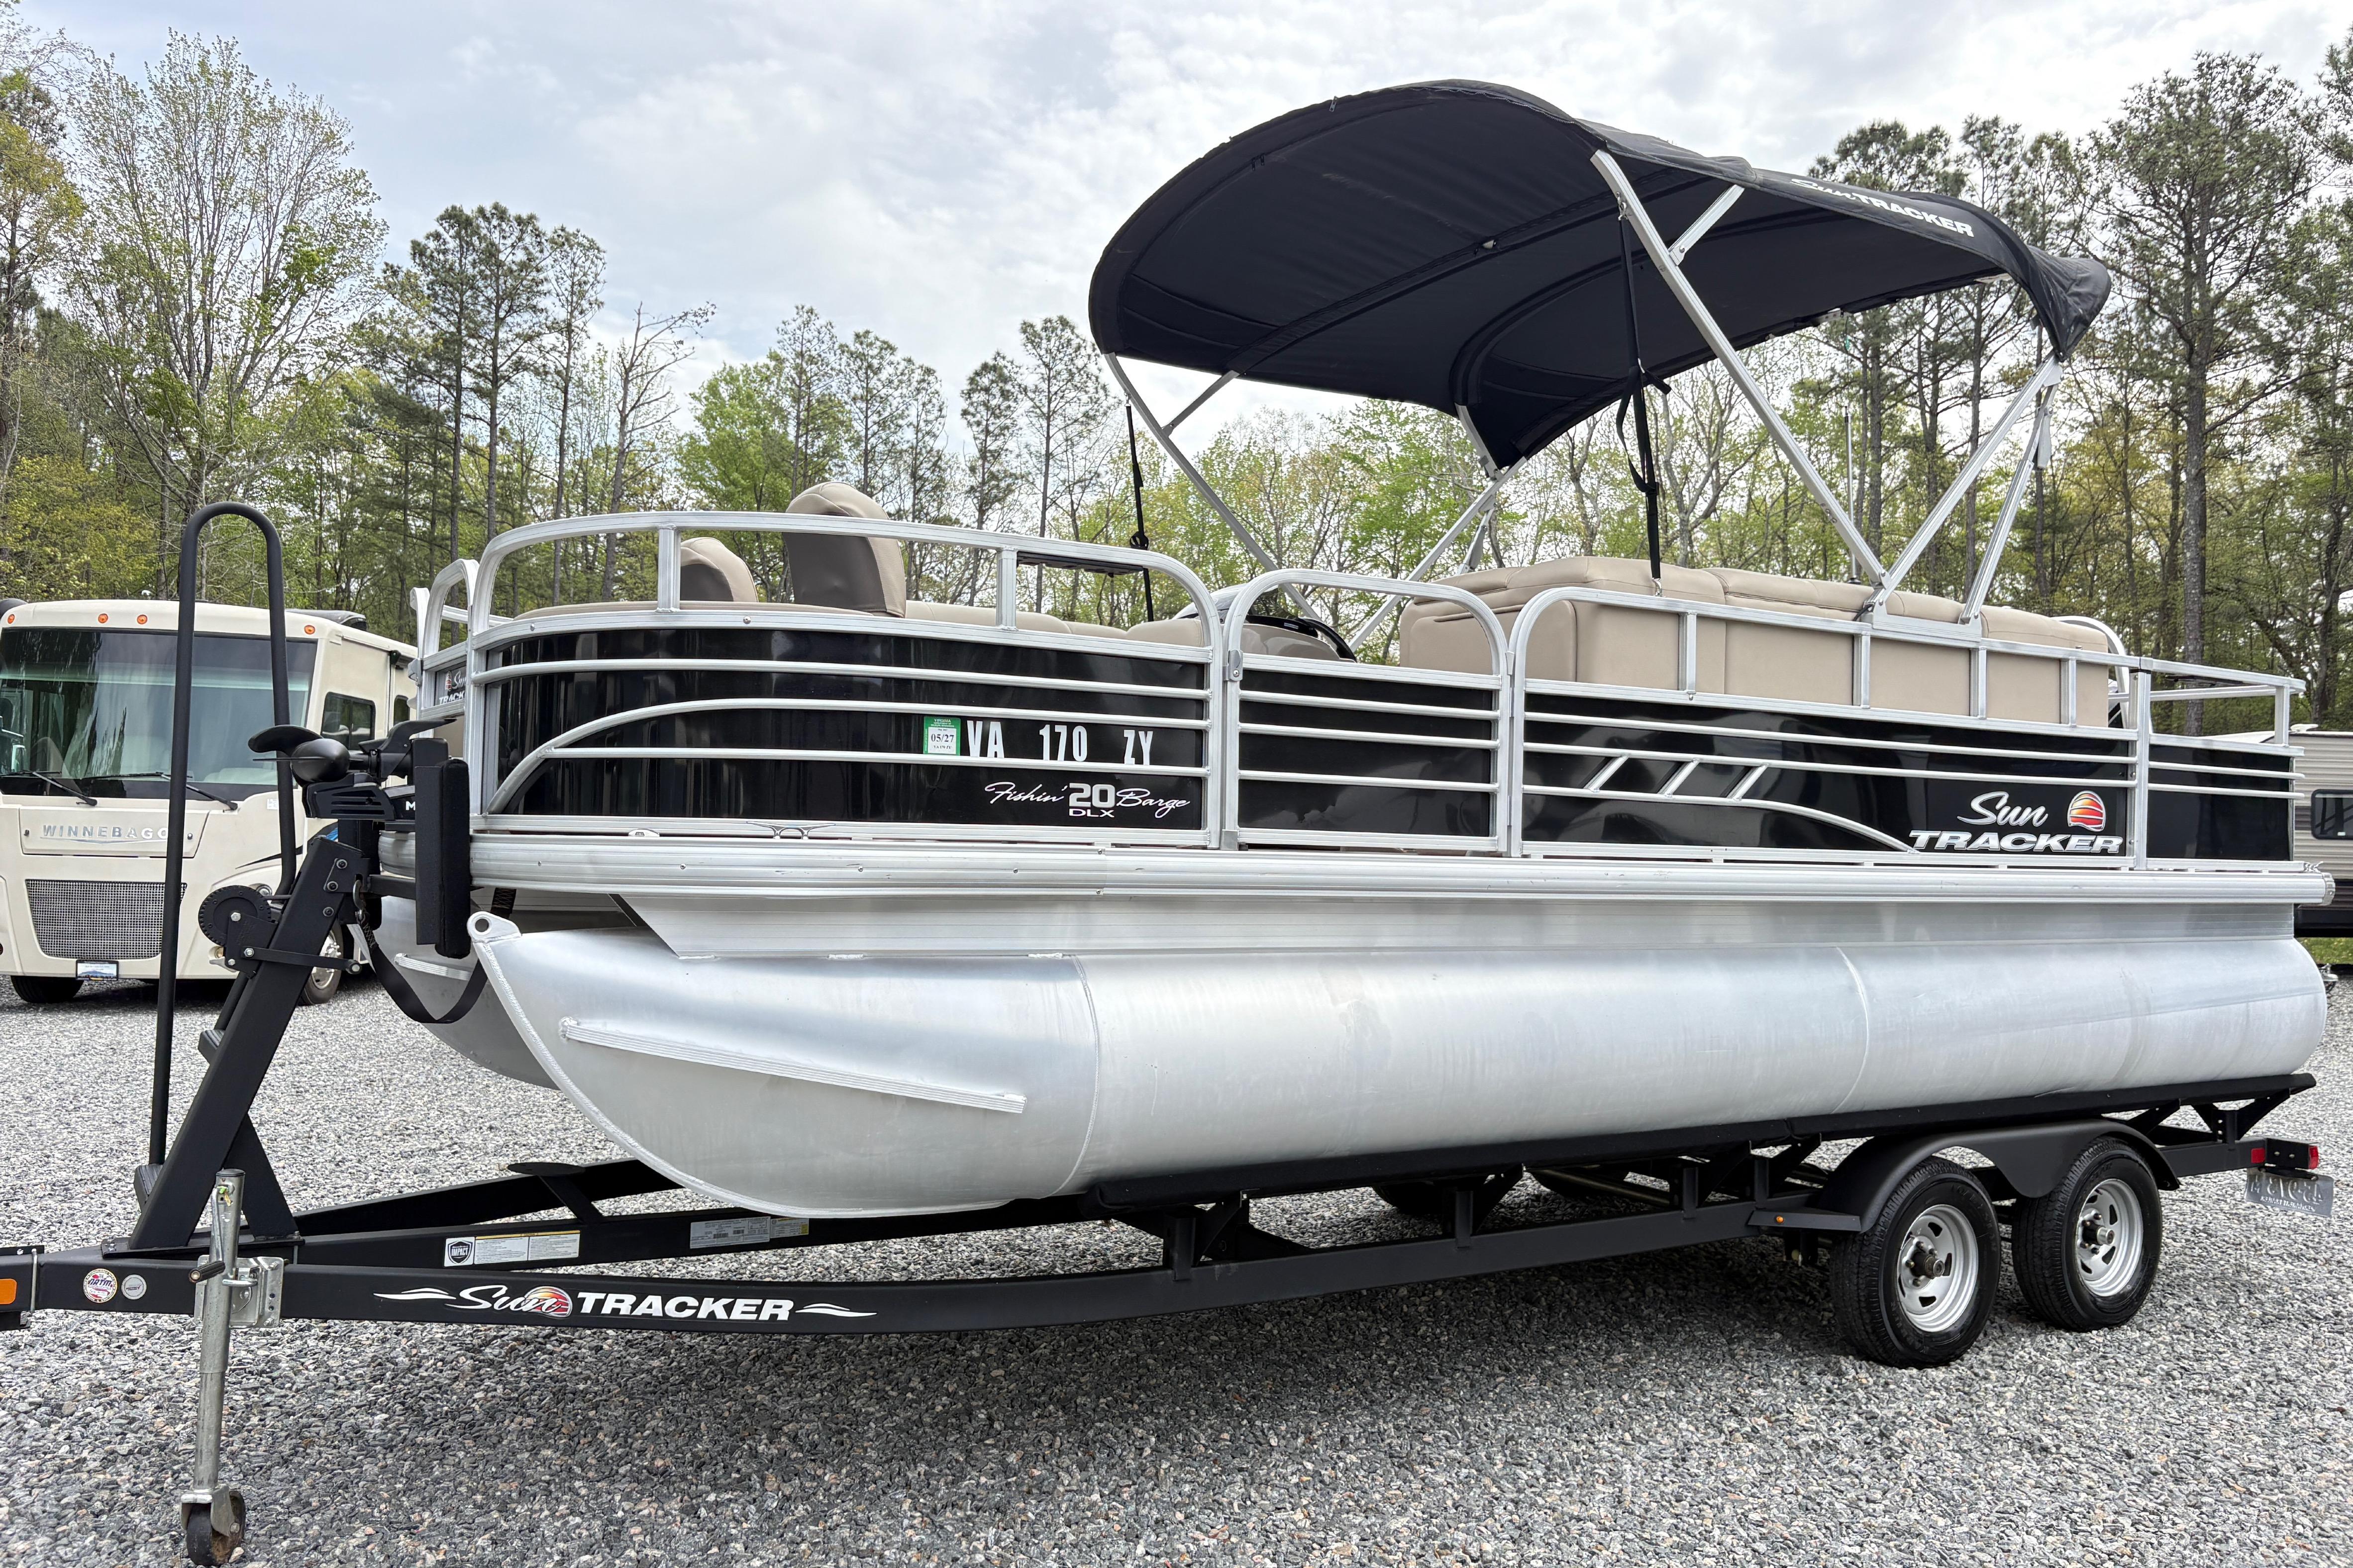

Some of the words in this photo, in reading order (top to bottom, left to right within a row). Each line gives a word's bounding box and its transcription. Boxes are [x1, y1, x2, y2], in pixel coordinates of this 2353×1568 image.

[1790, 178, 1856, 200] Sun
[1850, 193, 1974, 237] TRACKER
[439, 690, 466, 705] TRACK
[931, 734, 954, 742] 05/27
[967, 720, 1005, 759] VA
[1039, 724, 1088, 762] 170
[1123, 730, 1153, 766] ZY
[985, 782, 1068, 804] Fishin'
[1069, 783, 1116, 808] 20
[1116, 788, 1190, 818] Barge
[1957, 791, 2048, 827] Sun
[1069, 808, 1115, 818] DLX
[43, 824, 169, 839] WINNEBAGO
[1909, 830, 2123, 854] TRACKER
[451, 1248, 469, 1257] IMPACT
[444, 1285, 563, 1311] Sun
[577, 1292, 795, 1321] TRACKER
